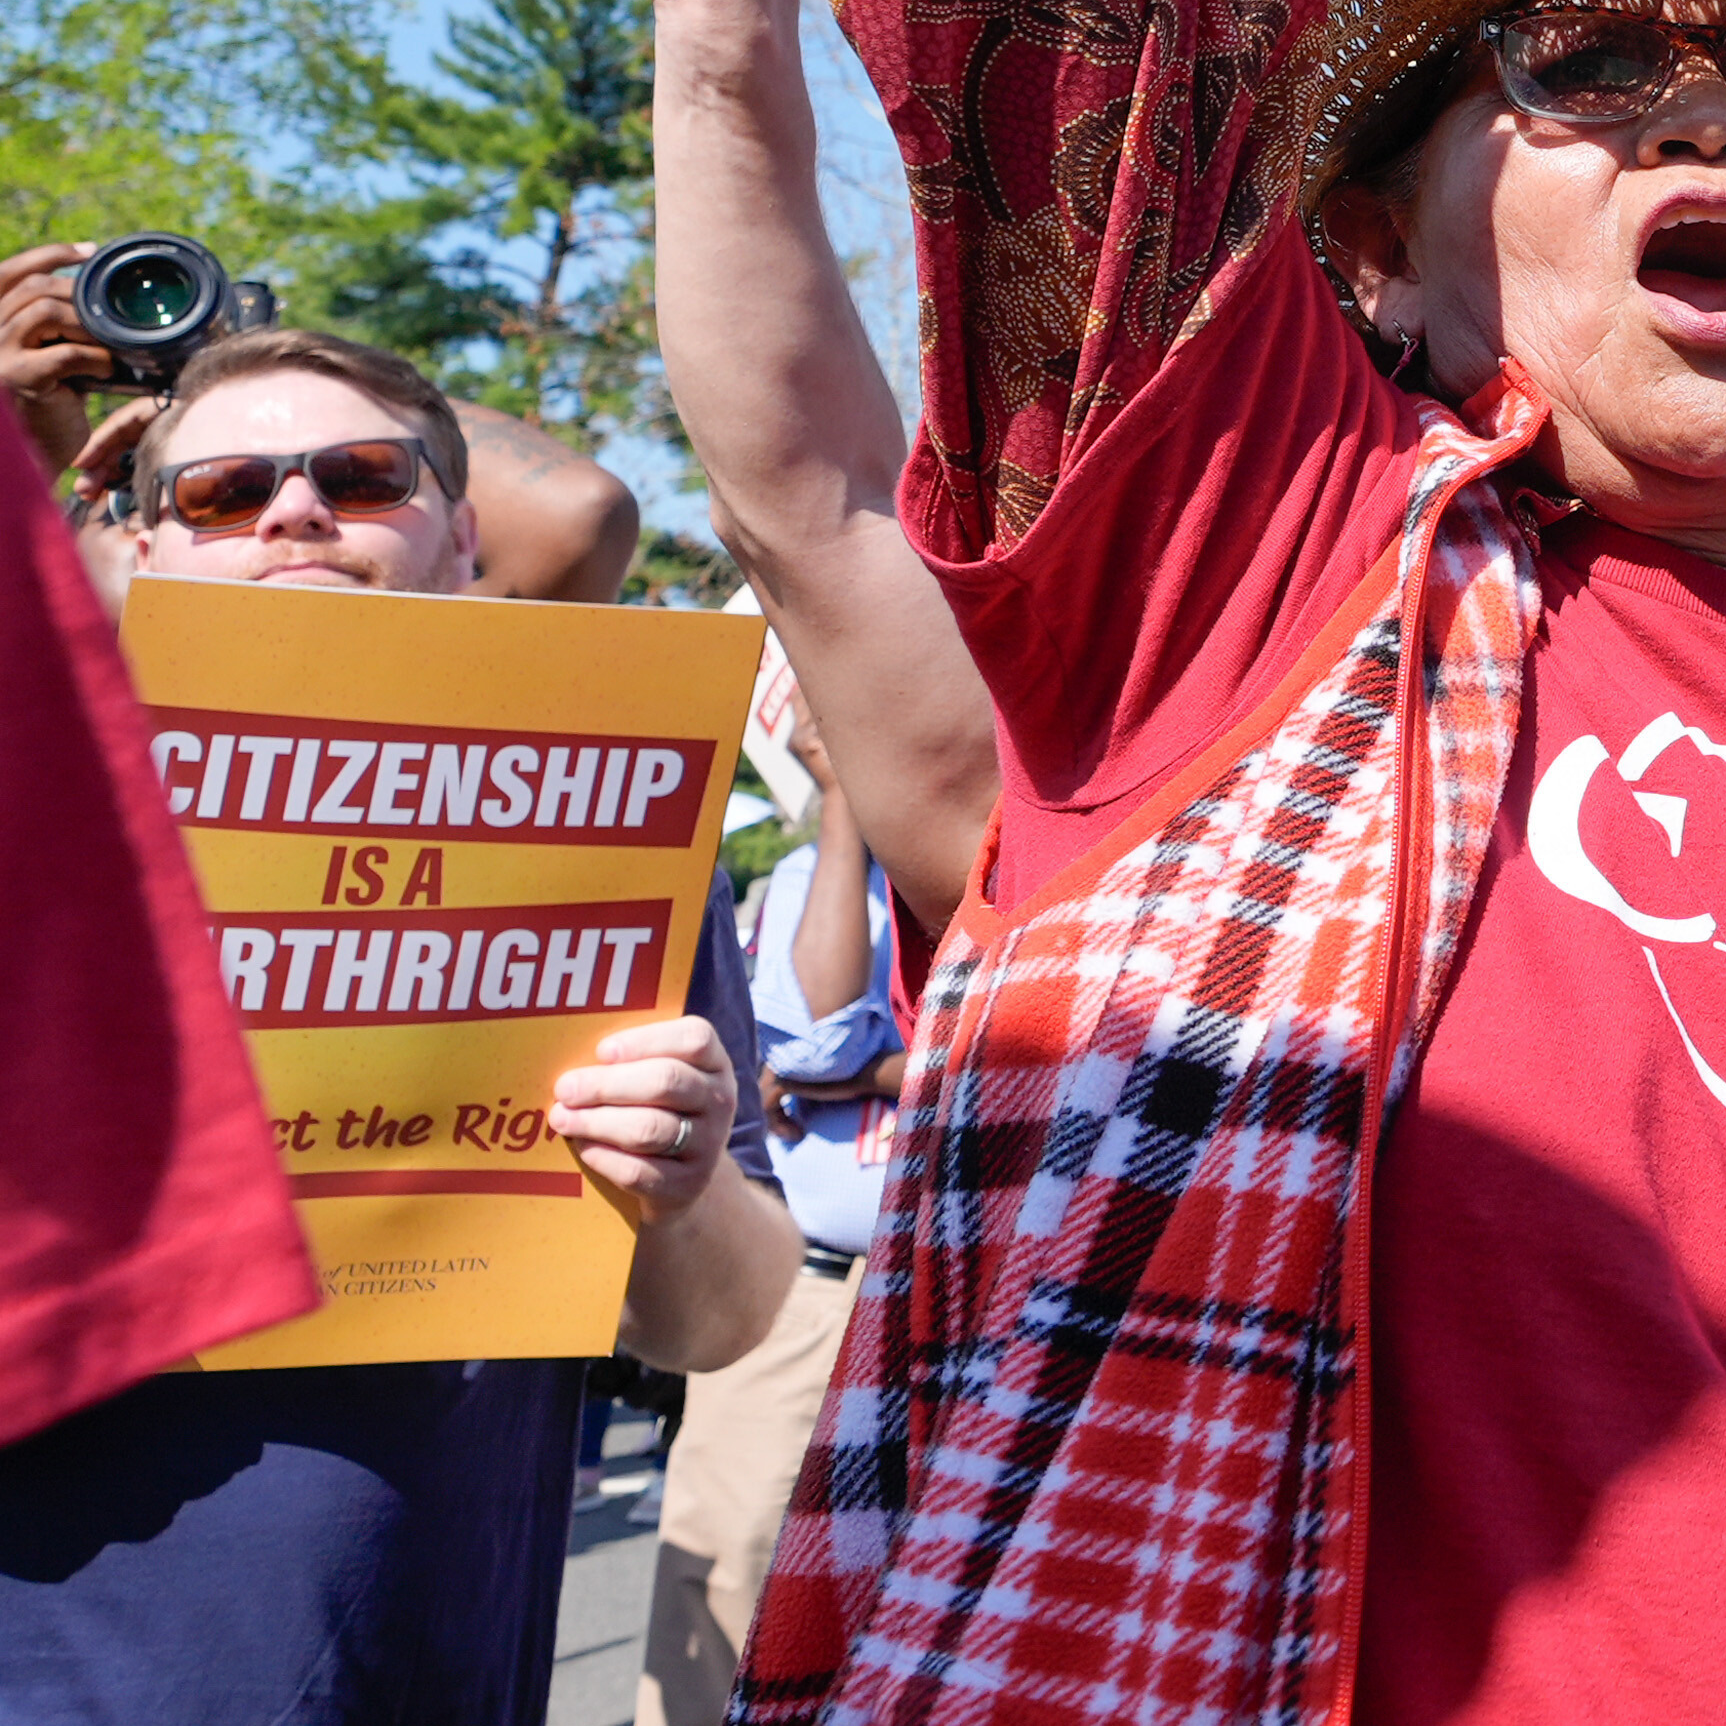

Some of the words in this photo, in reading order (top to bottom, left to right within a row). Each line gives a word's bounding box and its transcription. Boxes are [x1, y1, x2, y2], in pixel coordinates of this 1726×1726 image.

[150, 730, 684, 828] CITIZENSHIP
[321, 846, 388, 906] IS
[401, 849, 444, 906] A
[207, 927, 652, 1012] RTHRIGHT
[336, 1104, 433, 1151] the
[452, 1097, 560, 1153] Rig
[344, 1277, 437, 1296] CITIZENS
[348, 1258, 427, 1277] UNITED
[431, 1256, 490, 1273] LATIN
